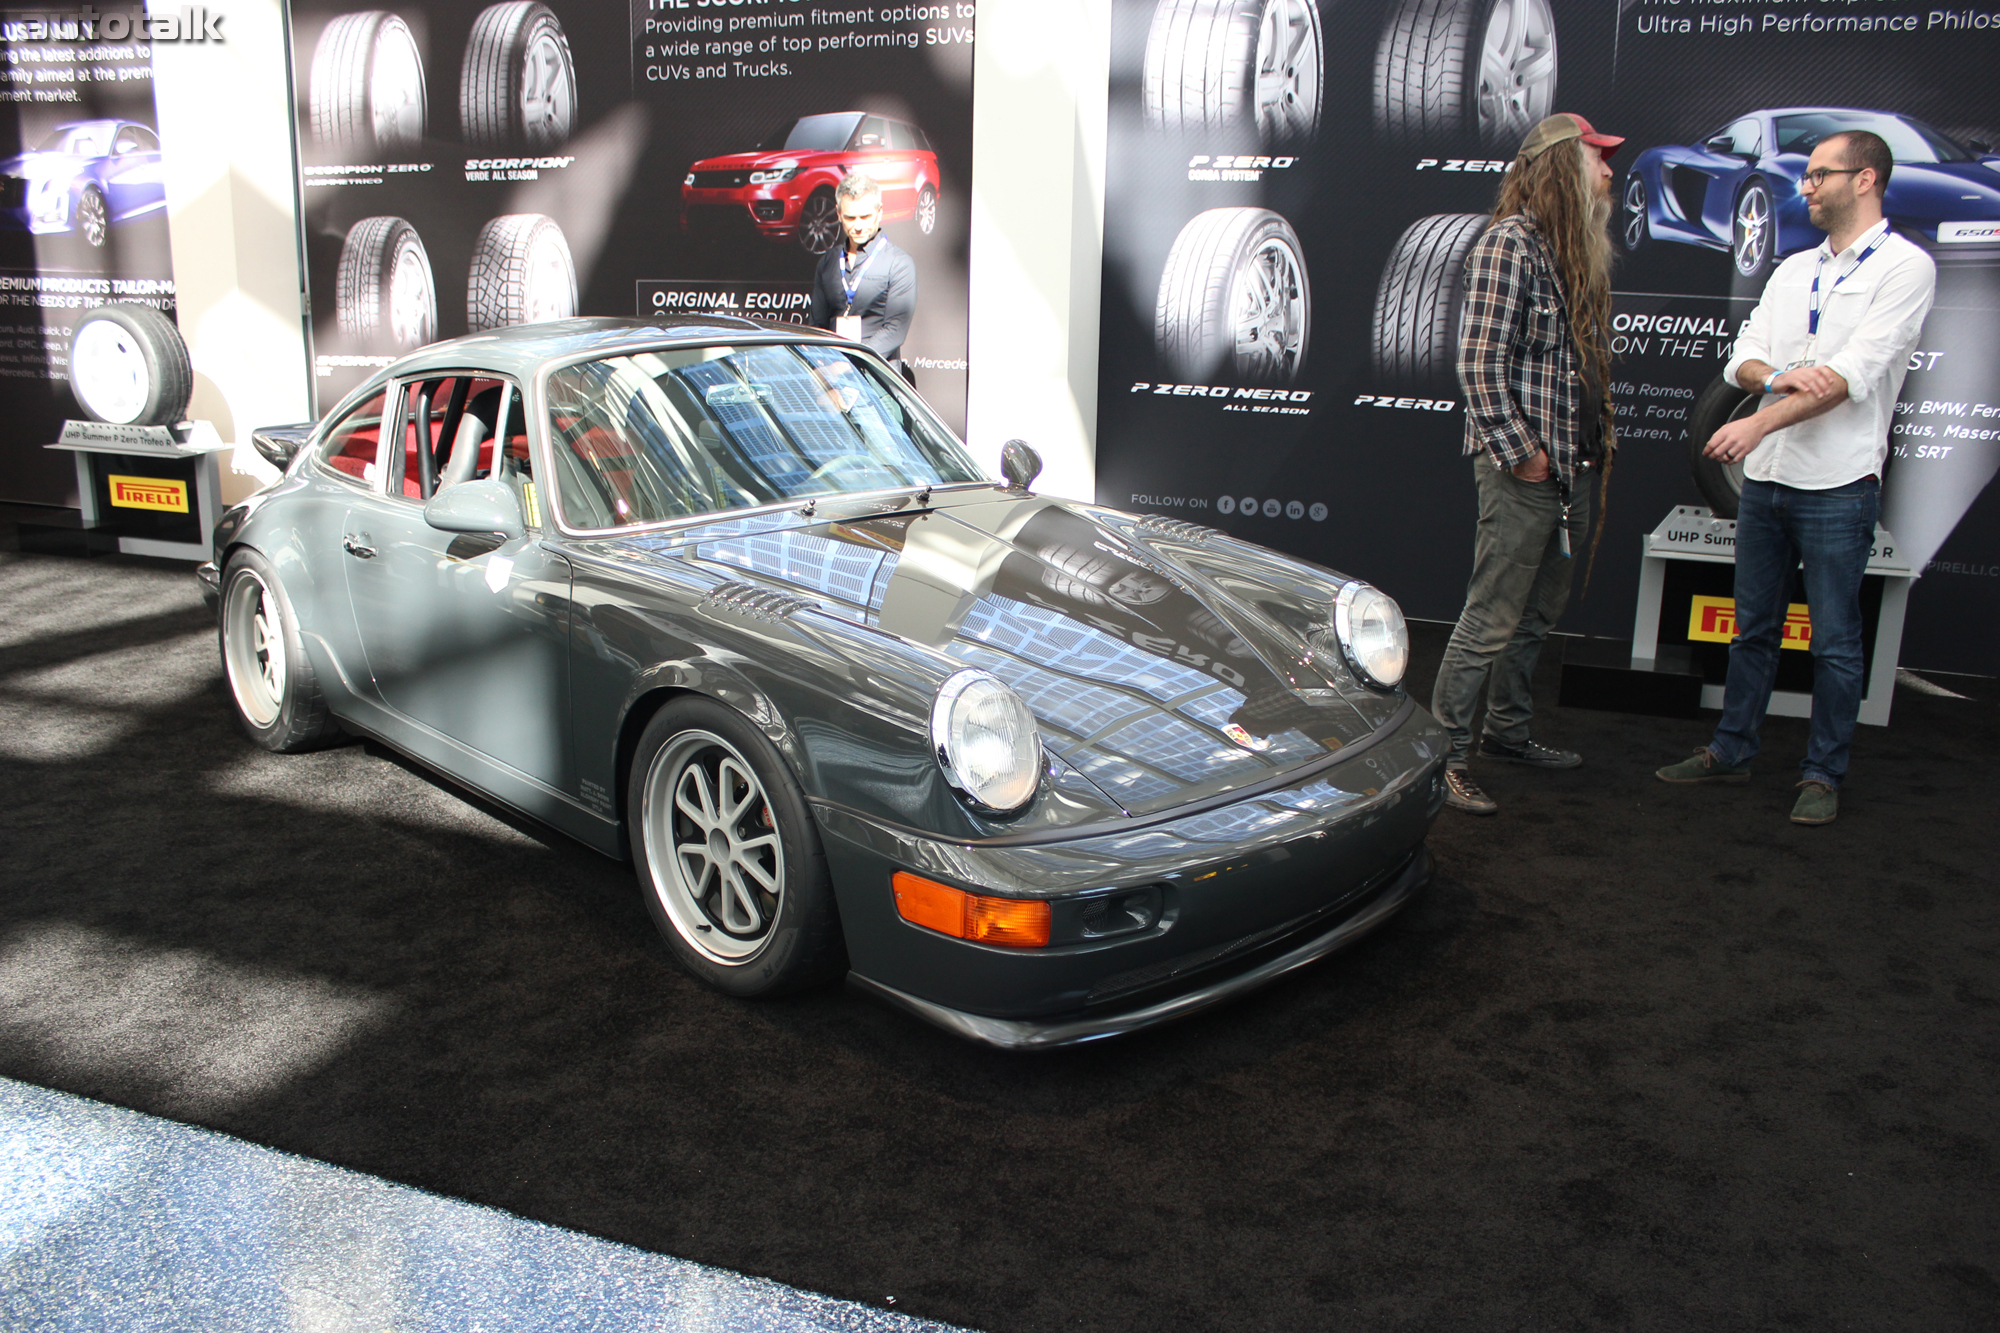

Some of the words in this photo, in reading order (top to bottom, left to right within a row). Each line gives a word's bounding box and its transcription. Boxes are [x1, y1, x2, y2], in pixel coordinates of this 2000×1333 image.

[646, 16, 723, 34] Providing
[730, 12, 805, 32] premium
[811, 7, 874, 26] fitment
[881, 4, 950, 24] options
[956, 2, 975, 18] to
[1637, 14, 1692, 34] Ultra
[1700, 13, 1753, 36] High
[1762, 11, 1918, 33] Performance
[646, 45, 655, 58] a
[660, 40, 700, 57] wide
[706, 41, 754, 57] range
[759, 36, 777, 53] of
[783, 36, 812, 53] top
[818, 30, 919, 52] performing
[926, 26, 974, 46] SUVs
[20, 46, 41, 62] the
[41, 46, 76, 62] latest
[78, 44, 135, 62] additions
[135, 43, 151, 60] to
[34, 67, 75, 83] aimed
[78, 68, 92, 82] at
[92, 66, 116, 81] the
[646, 64, 690, 81] CUVs
[696, 62, 726, 79] and
[733, 60, 792, 78] Trucks.
[34, 86, 82, 102] market.
[387, 163, 432, 173] ZERO
[464, 156, 571, 170] SCORPION
[1188, 155, 1210, 168] P
[1212, 155, 1294, 169] ZERO
[1416, 158, 1438, 170] P
[465, 171, 490, 182] VERDE
[492, 170, 506, 180] ALL
[508, 169, 538, 180] SEASON
[40, 277, 110, 294] PRODUCTS
[12, 294, 30, 307] THE
[32, 295, 65, 308] NEEDS
[66, 296, 82, 309] OF
[652, 291, 739, 308] ORIGINAL
[1612, 313, 1730, 338] ORIGINAL
[1610, 335, 1650, 355] ON
[1659, 338, 1708, 359] THE
[1131, 382, 1150, 393] P
[1154, 383, 1230, 398] ZERO
[1233, 388, 1312, 402] NERO
[1608, 382, 1635, 395] Alfa
[1638, 384, 1695, 400] Romeo,
[1222, 404, 1249, 412] ALL
[1252, 405, 1310, 416] SEASON
[1610, 403, 1638, 418] iat,
[1645, 405, 1688, 421] Ford,
[1919, 400, 1968, 418] BMW,
[65, 431, 80, 439] UHP
[82, 432, 112, 442] Summer
[114, 434, 119, 443] P
[121, 435, 138, 444] Zero
[140, 436, 164, 447] Trofeo
[166, 438, 172, 448] R
[1614, 425, 1672, 442] cLaren,
[1914, 444, 1954, 460] SRT
[116, 482, 180, 506] PIRELLI
[1132, 494, 1186, 507] FOLLOW
[1189, 498, 1208, 509] ON
[1668, 530, 1700, 543] UHP
[1882, 546, 1894, 558] R
